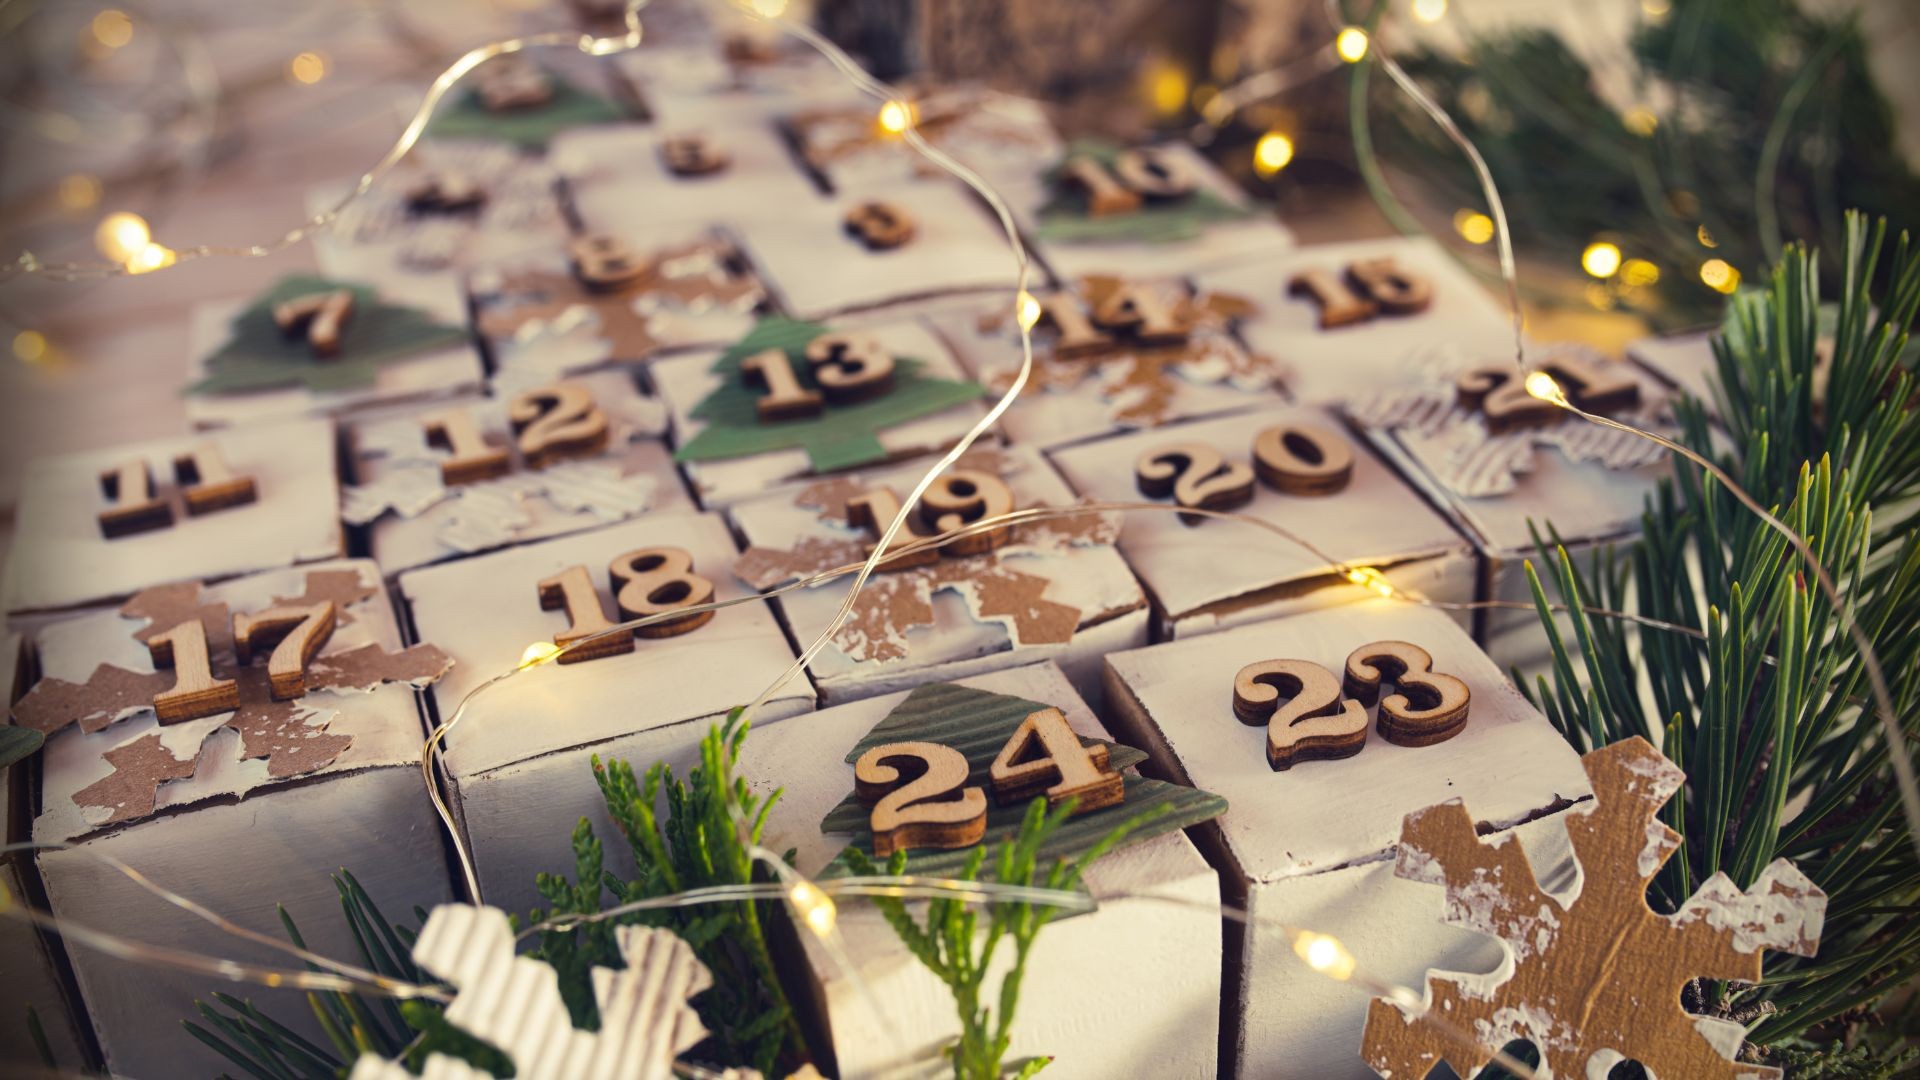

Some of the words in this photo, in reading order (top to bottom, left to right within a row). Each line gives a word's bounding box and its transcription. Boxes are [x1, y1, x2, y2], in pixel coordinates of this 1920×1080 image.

[272, 289, 355, 358] 7
[1041, 275, 1192, 360] 14
[740, 331, 896, 424] 13
[1456, 353, 1641, 435] 21
[423, 384, 610, 486] 12
[1136, 423, 1355, 527] 20
[98, 442, 258, 539] 11
[846, 468, 1016, 572] 19
[538, 545, 717, 665] 18
[147, 600, 336, 727] 17
[1233, 640, 1471, 772] 23
[855, 706, 1125, 858] 24
